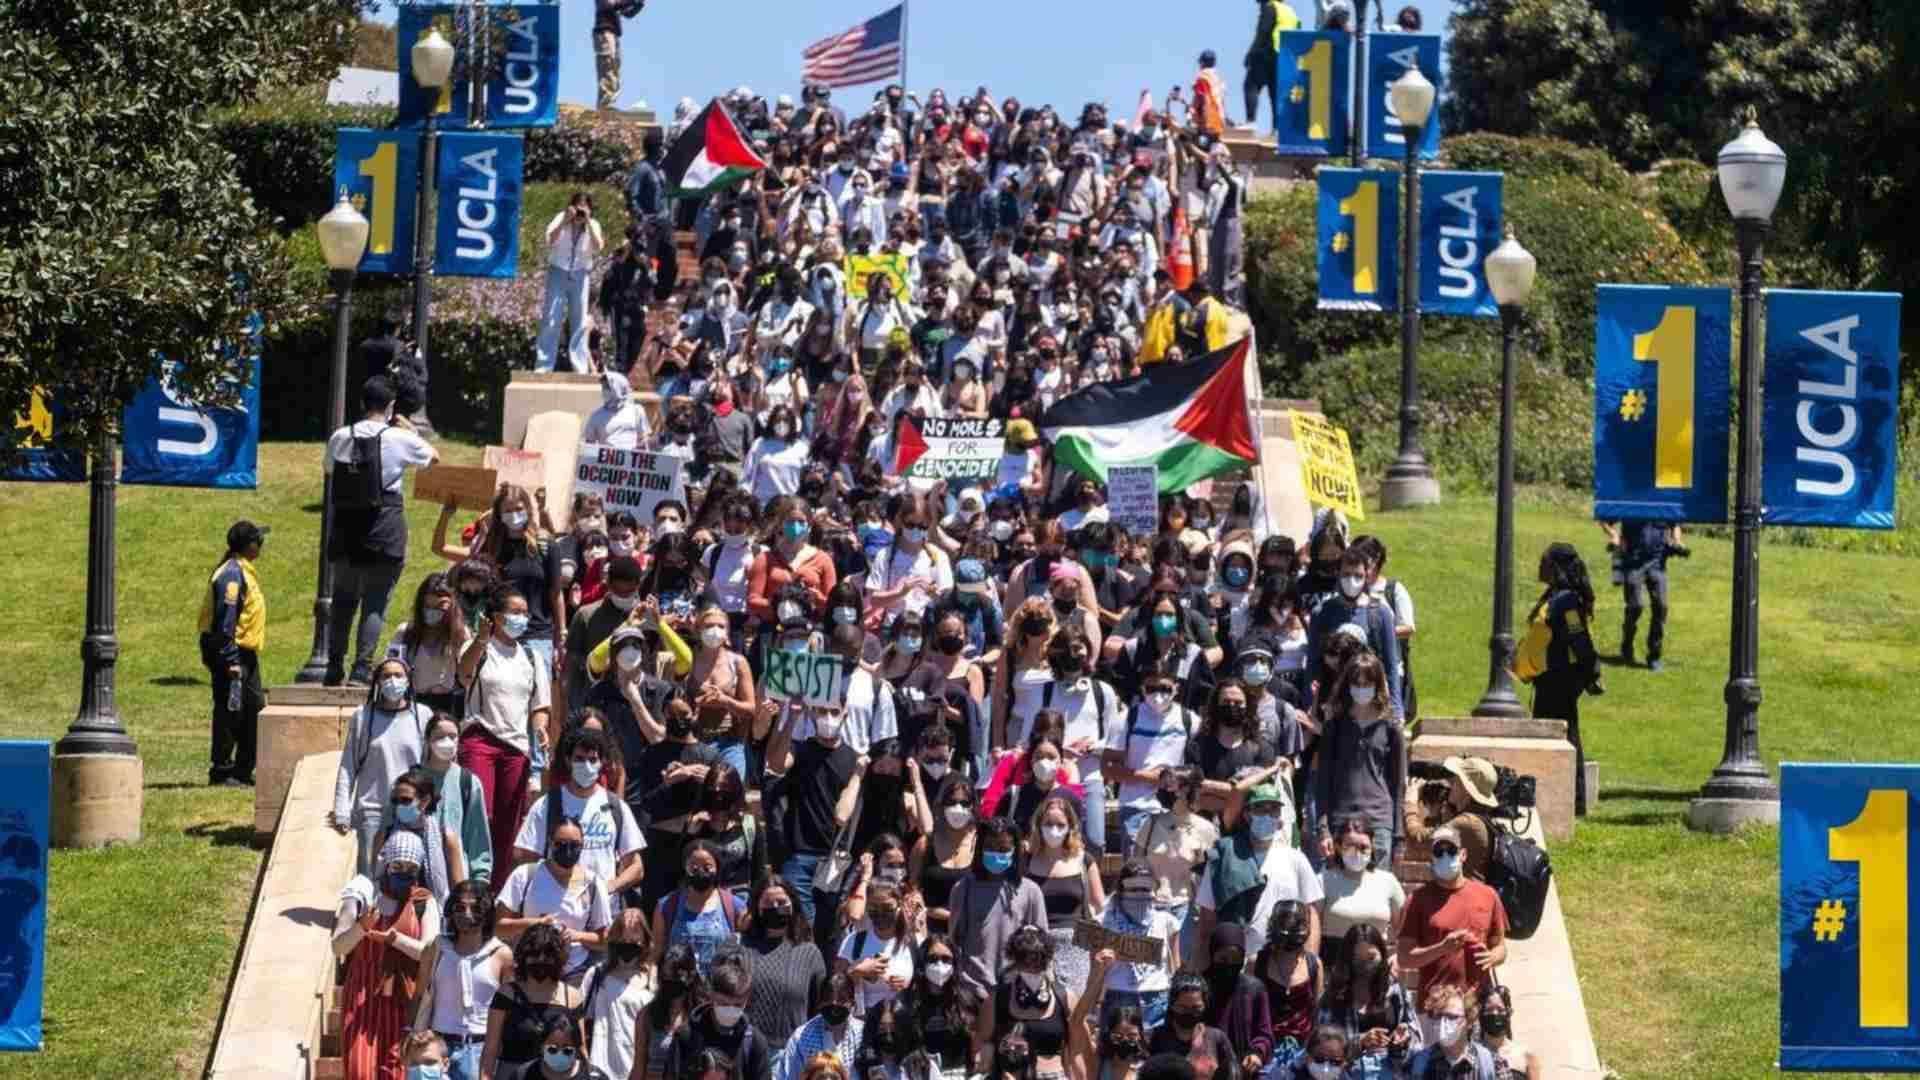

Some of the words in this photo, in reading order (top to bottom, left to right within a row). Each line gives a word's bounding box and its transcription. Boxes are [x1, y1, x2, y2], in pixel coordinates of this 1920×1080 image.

[504, 16, 539, 113] UCLA
[456, 148, 498, 259] UCLA
[1438, 186, 1478, 298] UCLA
[1618, 306, 1695, 488] #1
[1795, 314, 1859, 496] UCLA
[922, 419, 947, 436] NO
[948, 442, 977, 456] FOR
[579, 463, 671, 491] OCCUPATION
[598, 448, 625, 465] END
[630, 451, 657, 470] THE
[913, 458, 999, 478] GENOCIDE!
[606, 487, 642, 506] NOW
[767, 649, 842, 702] RESIST
[1812, 789, 1909, 1028] #1
